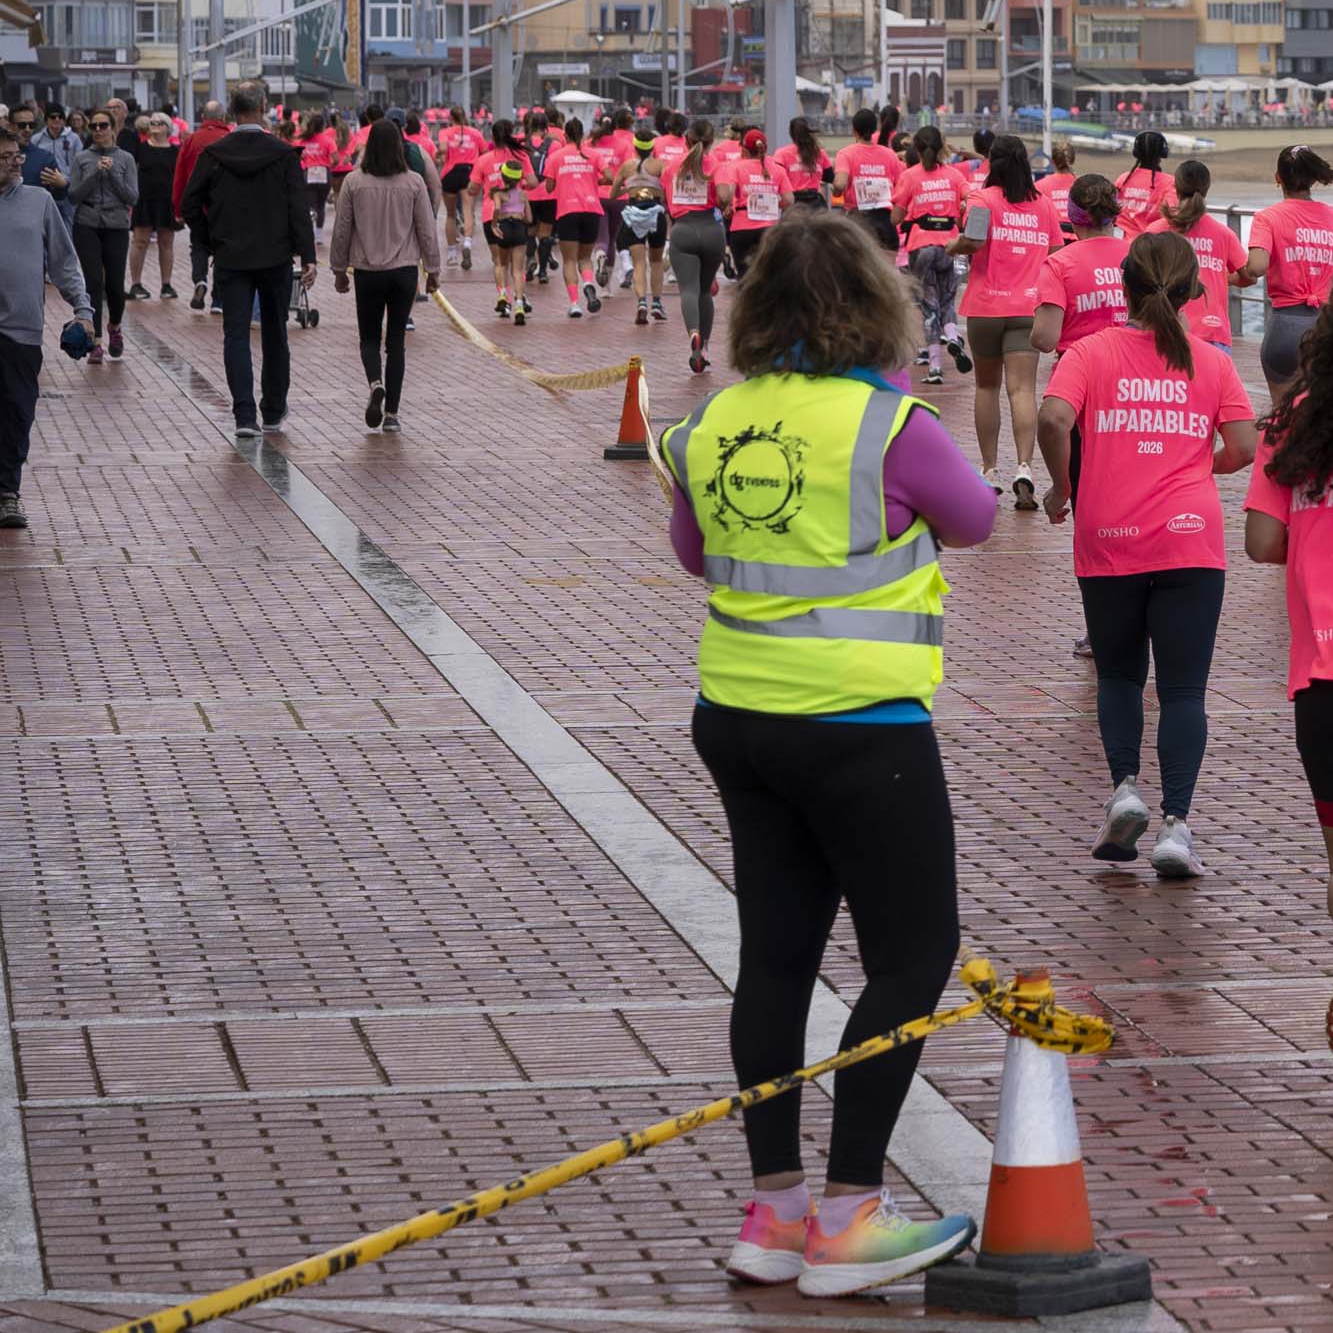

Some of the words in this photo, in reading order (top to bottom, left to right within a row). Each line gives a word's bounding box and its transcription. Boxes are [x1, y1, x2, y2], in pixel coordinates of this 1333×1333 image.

[1002, 211, 1038, 228] SOMOS
[1094, 267, 1125, 285] SOM
[1076, 289, 1127, 313] IMPAR
[1117, 378, 1187, 404] SOMOS
[1138, 441, 1163, 454] 2026
[1098, 526, 1139, 539] OYSHO
